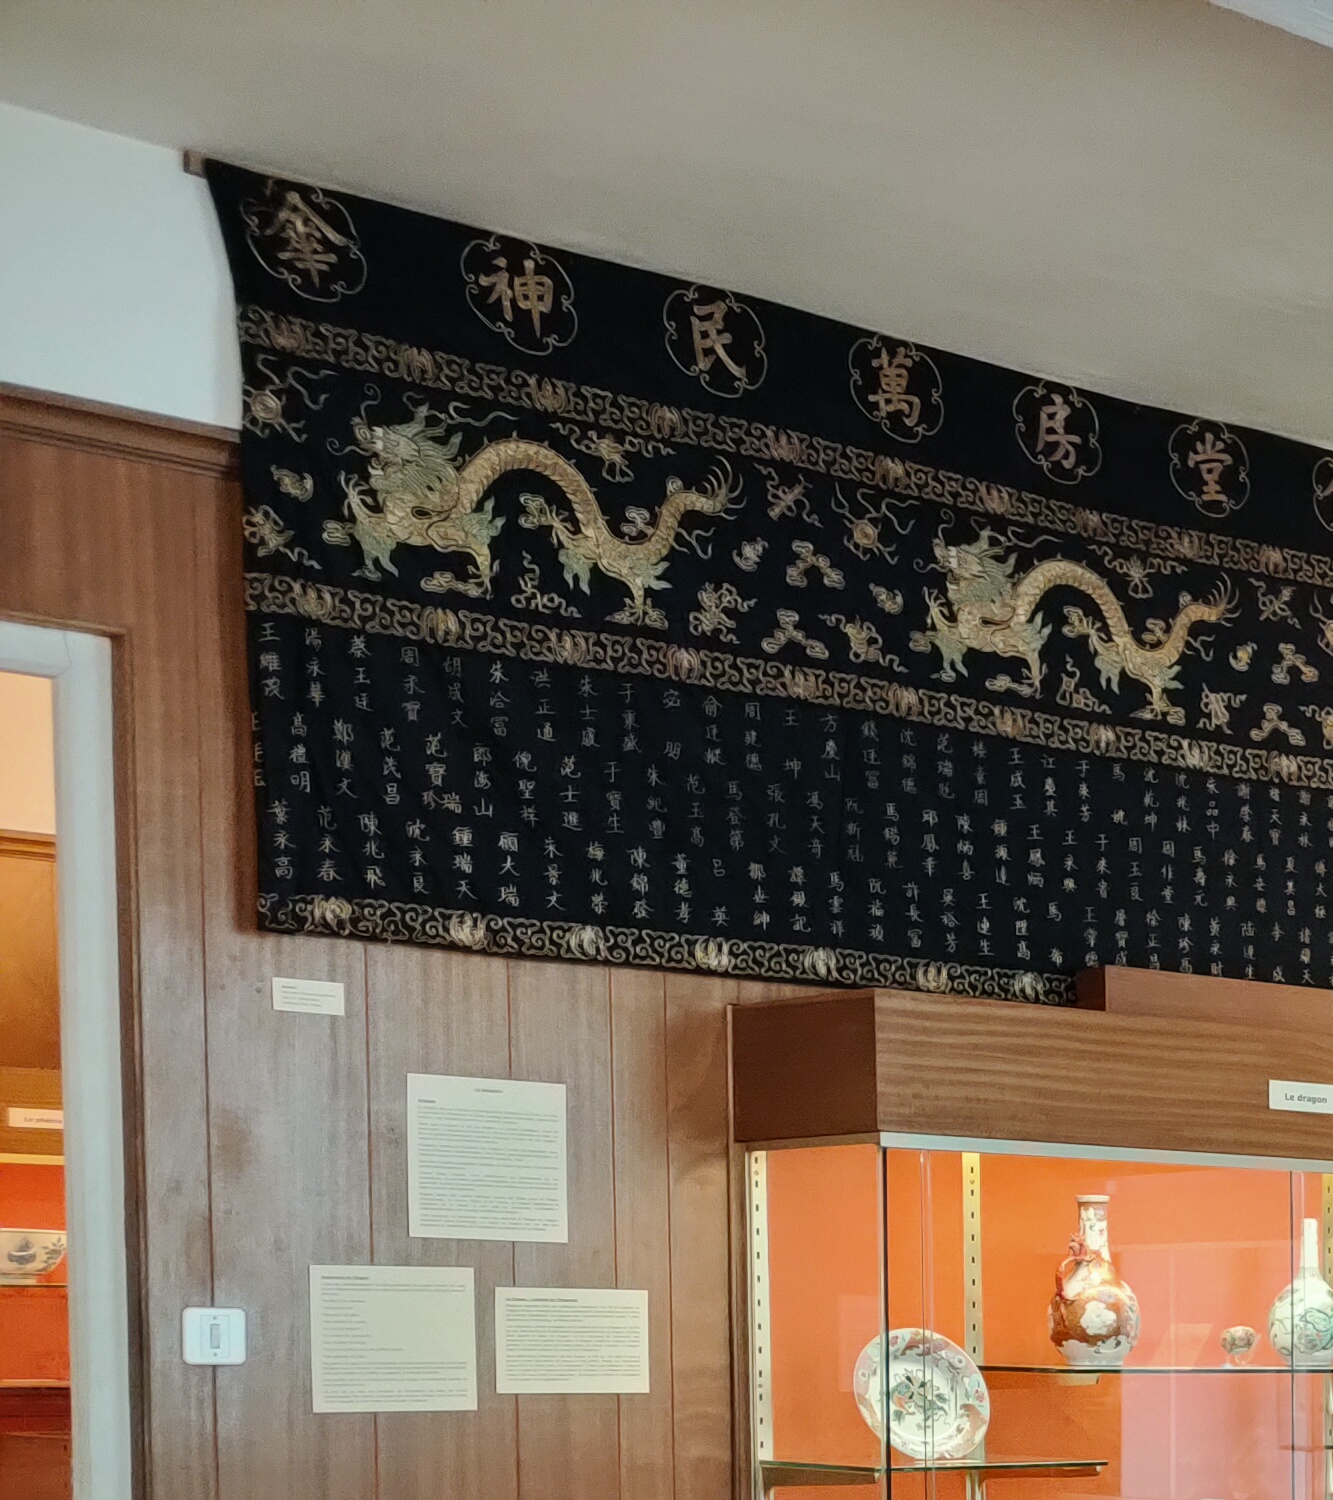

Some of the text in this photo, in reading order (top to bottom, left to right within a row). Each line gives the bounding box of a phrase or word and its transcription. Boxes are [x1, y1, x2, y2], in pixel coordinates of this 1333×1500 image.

[479, 257, 555, 338] 神
[690, 300, 746, 380] 民
[868, 346, 921, 426] 萬
[1035, 395, 1082, 468] 房
[1188, 434, 1234, 499] 堂
[1285, 1092, 1328, 1105] Le dragon
